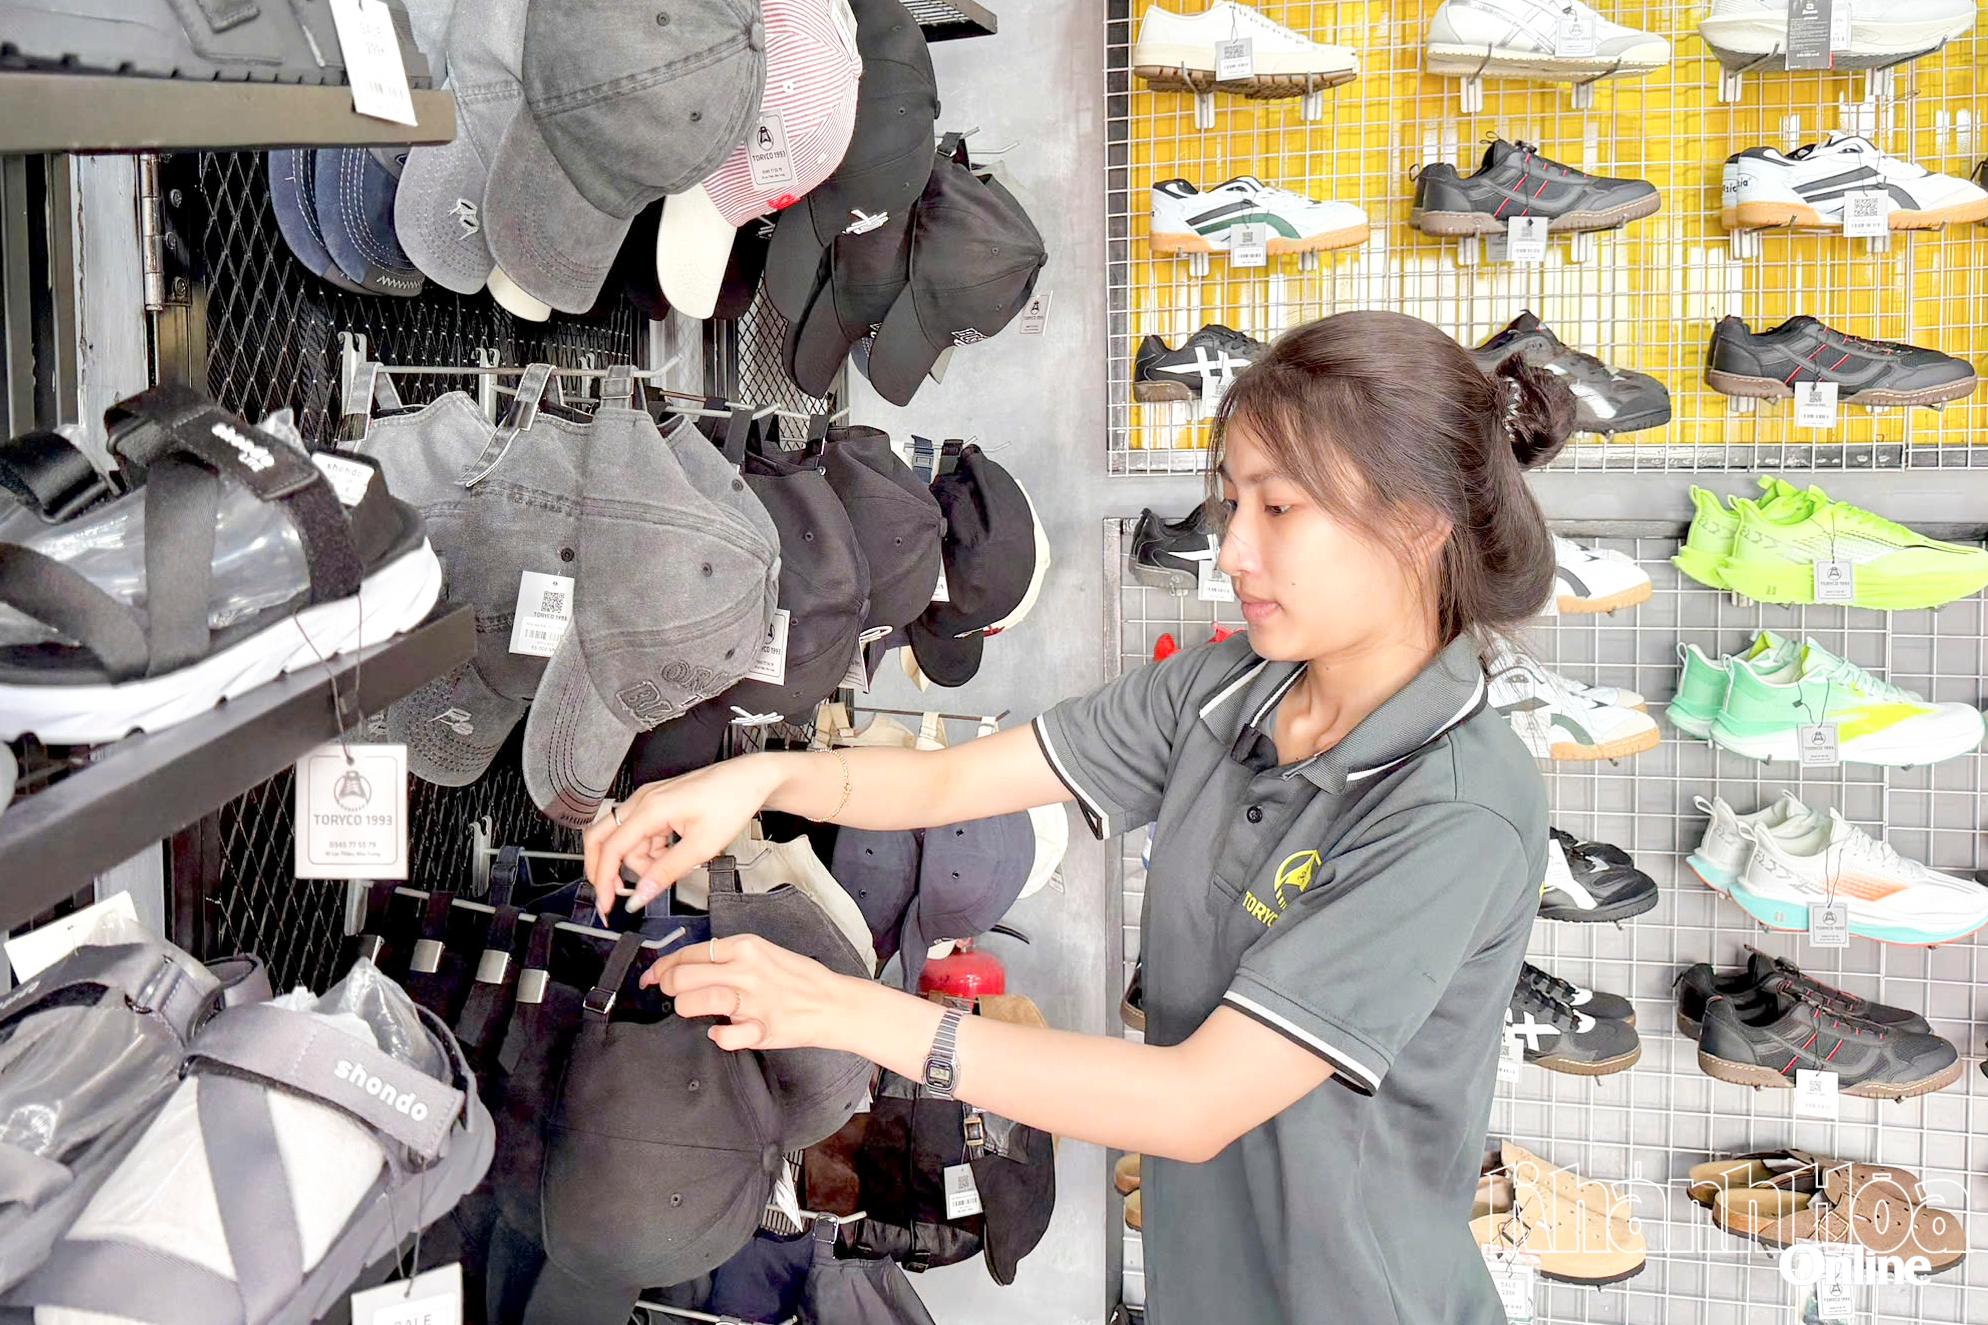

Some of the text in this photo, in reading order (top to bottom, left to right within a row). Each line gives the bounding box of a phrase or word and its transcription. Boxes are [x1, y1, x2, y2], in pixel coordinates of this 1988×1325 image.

[313, 814, 393, 826] TORYCO 1993
[1242, 890, 1281, 928] TORYC
[333, 1059, 428, 1121] shondo
